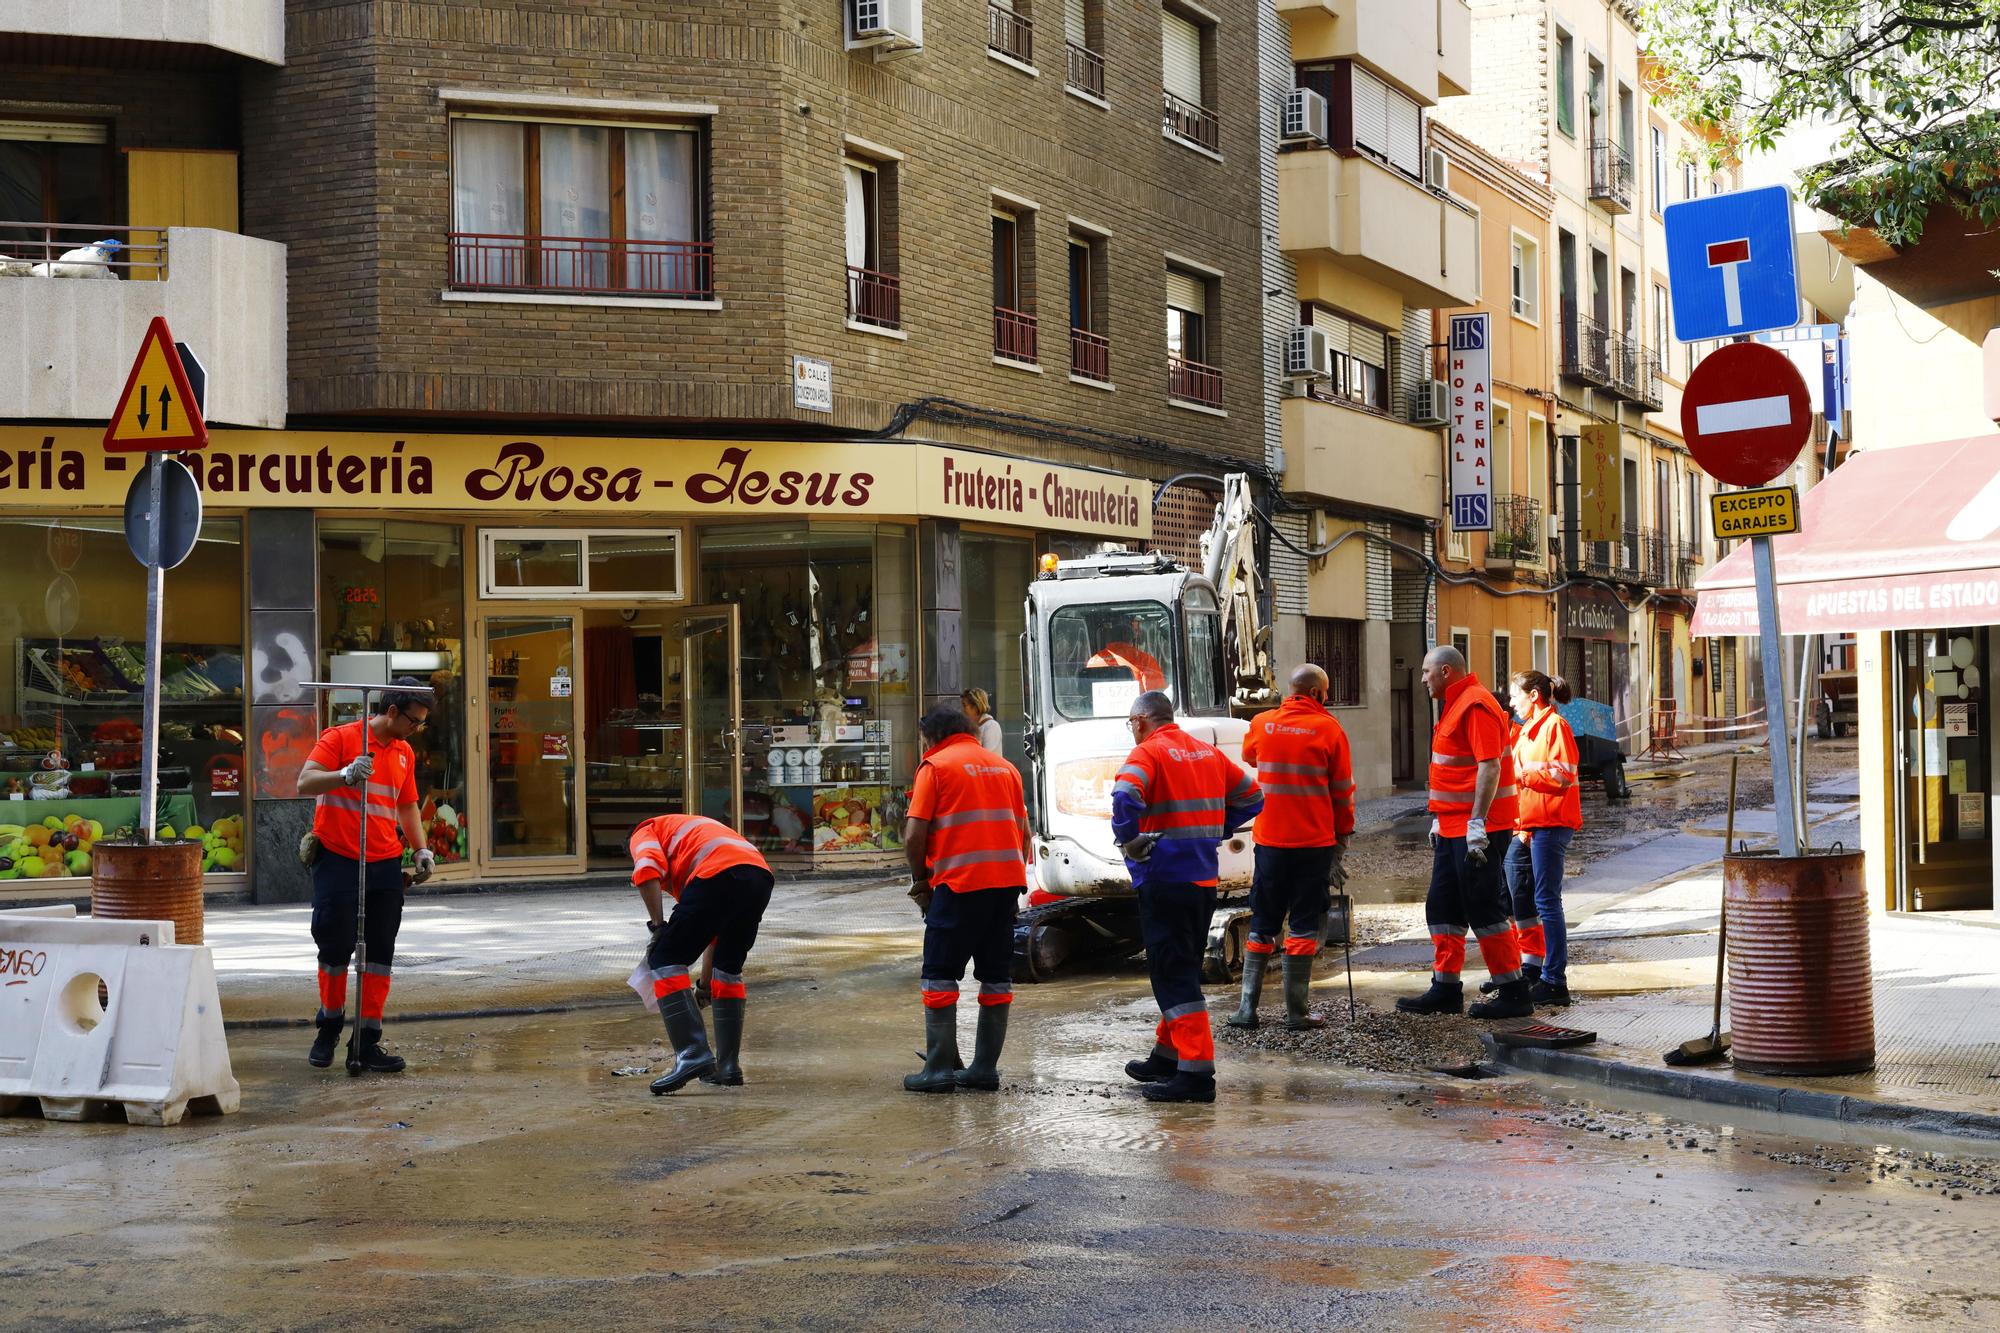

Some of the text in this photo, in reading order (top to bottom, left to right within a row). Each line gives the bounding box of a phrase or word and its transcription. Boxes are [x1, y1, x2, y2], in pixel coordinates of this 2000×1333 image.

[1454, 319, 1483, 349] HS
[808, 368, 826, 381] CALLE
[1454, 359, 1464, 462] HOSTAL
[1474, 383, 1485, 485] ARENAL
[465, 441, 642, 502] Rosa
[685, 447, 874, 507] Jesus
[944, 457, 1022, 513] Frutería
[1043, 472, 1138, 527] Charcutería
[1720, 494, 1785, 512] EXCEPTO
[1457, 495, 1486, 525] HS
[1722, 514, 1787, 531] GARAJES
[1807, 581, 1998, 616] APUESTAS DEL ESTADO
[1579, 604, 1614, 630] Ciudadela
[1702, 611, 1740, 626] TABACOS
[1276, 723, 1316, 736] Zaragoza
